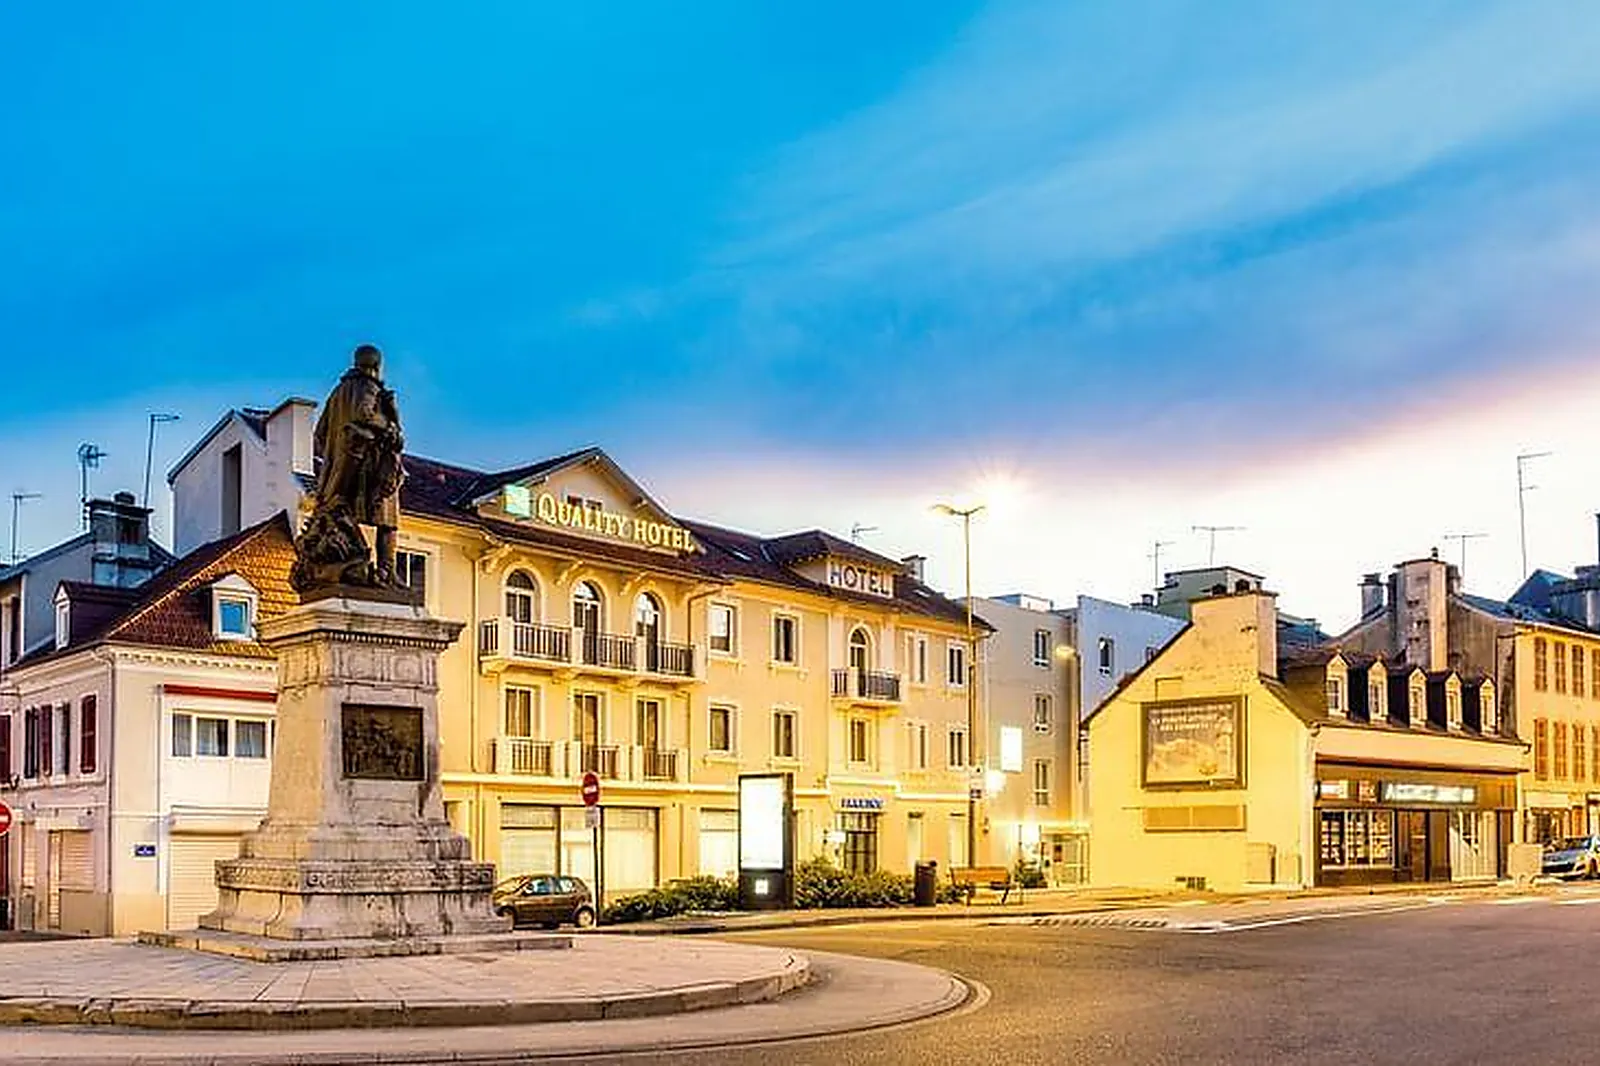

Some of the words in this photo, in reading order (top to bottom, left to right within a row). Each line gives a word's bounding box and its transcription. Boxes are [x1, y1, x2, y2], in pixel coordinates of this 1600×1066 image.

[537, 493, 628, 537] QUALITY
[633, 520, 695, 552] HOTEL
[828, 563, 891, 595] HOTEL
